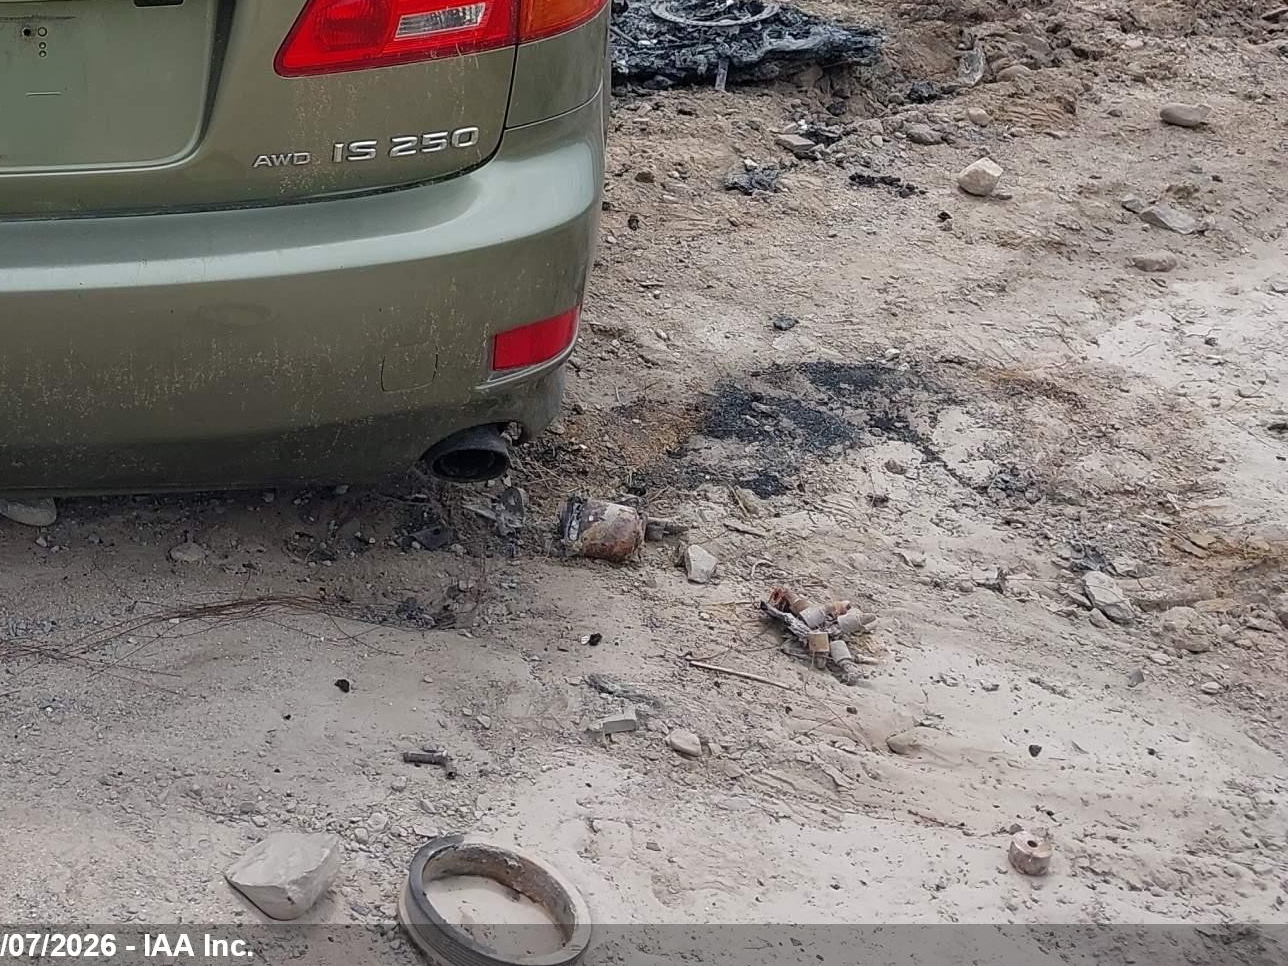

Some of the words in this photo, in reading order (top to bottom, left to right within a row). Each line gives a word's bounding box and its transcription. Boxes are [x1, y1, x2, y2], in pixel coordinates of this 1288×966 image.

[252, 152, 312, 168] AWD
[333, 140, 378, 162] IS
[389, 126, 480, 157] 250
